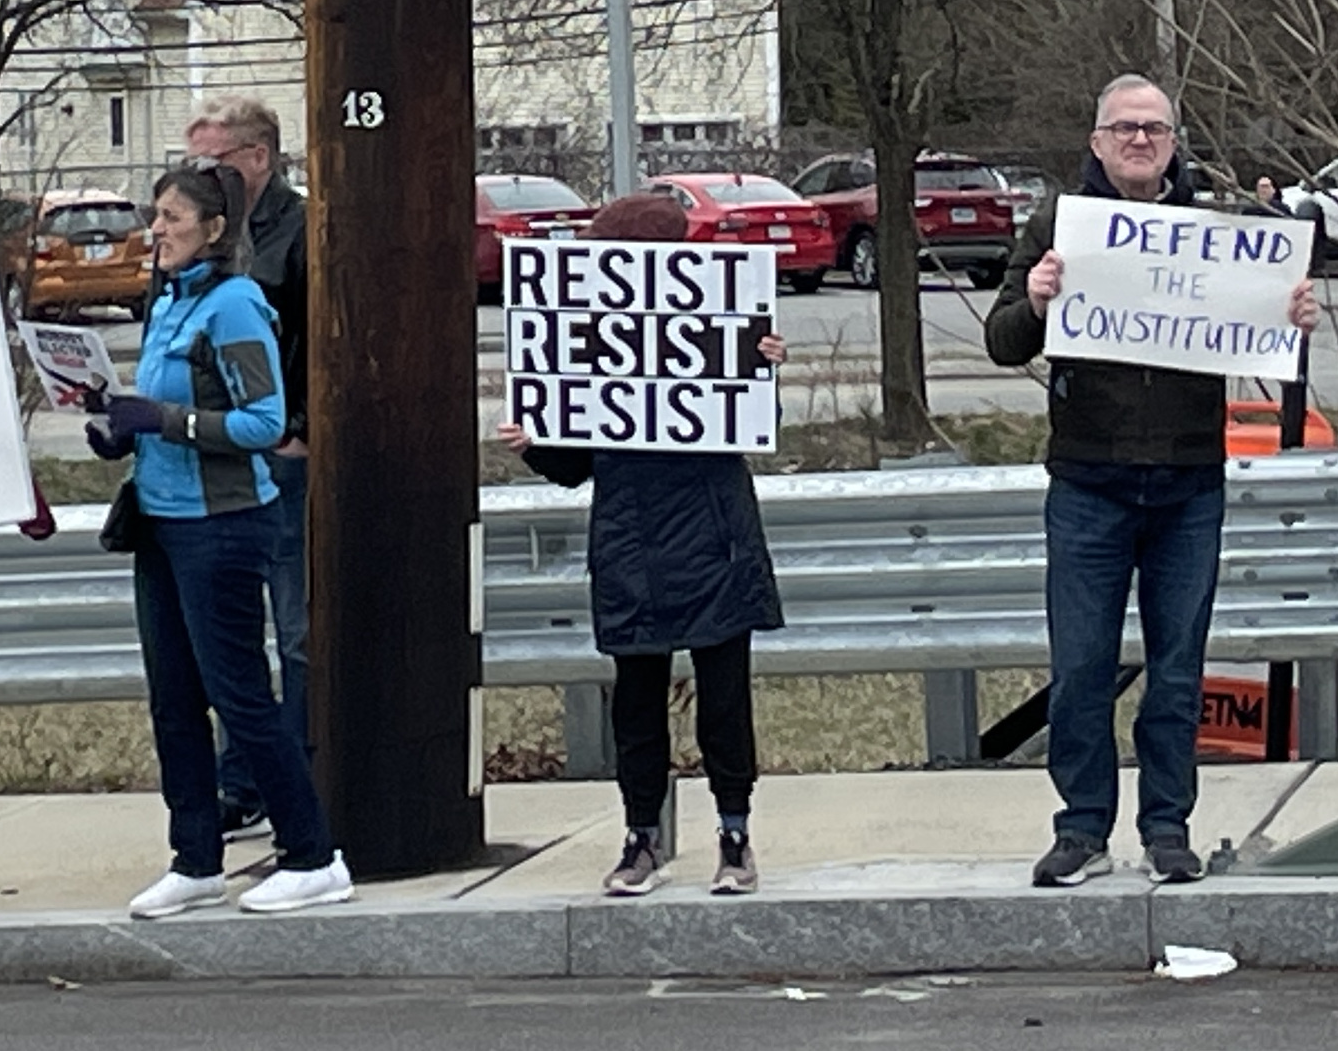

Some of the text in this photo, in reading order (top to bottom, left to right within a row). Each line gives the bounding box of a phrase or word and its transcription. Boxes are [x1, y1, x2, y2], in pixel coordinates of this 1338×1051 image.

[342, 91, 384, 128] 13
[1107, 213, 1292, 263] DEFEND
[511, 247, 769, 312] RESIST.
[1147, 266, 1210, 300] THE
[510, 311, 770, 379] RESIST.
[1061, 292, 1298, 355] CONSTITUTION
[513, 377, 769, 445] RESIST.
